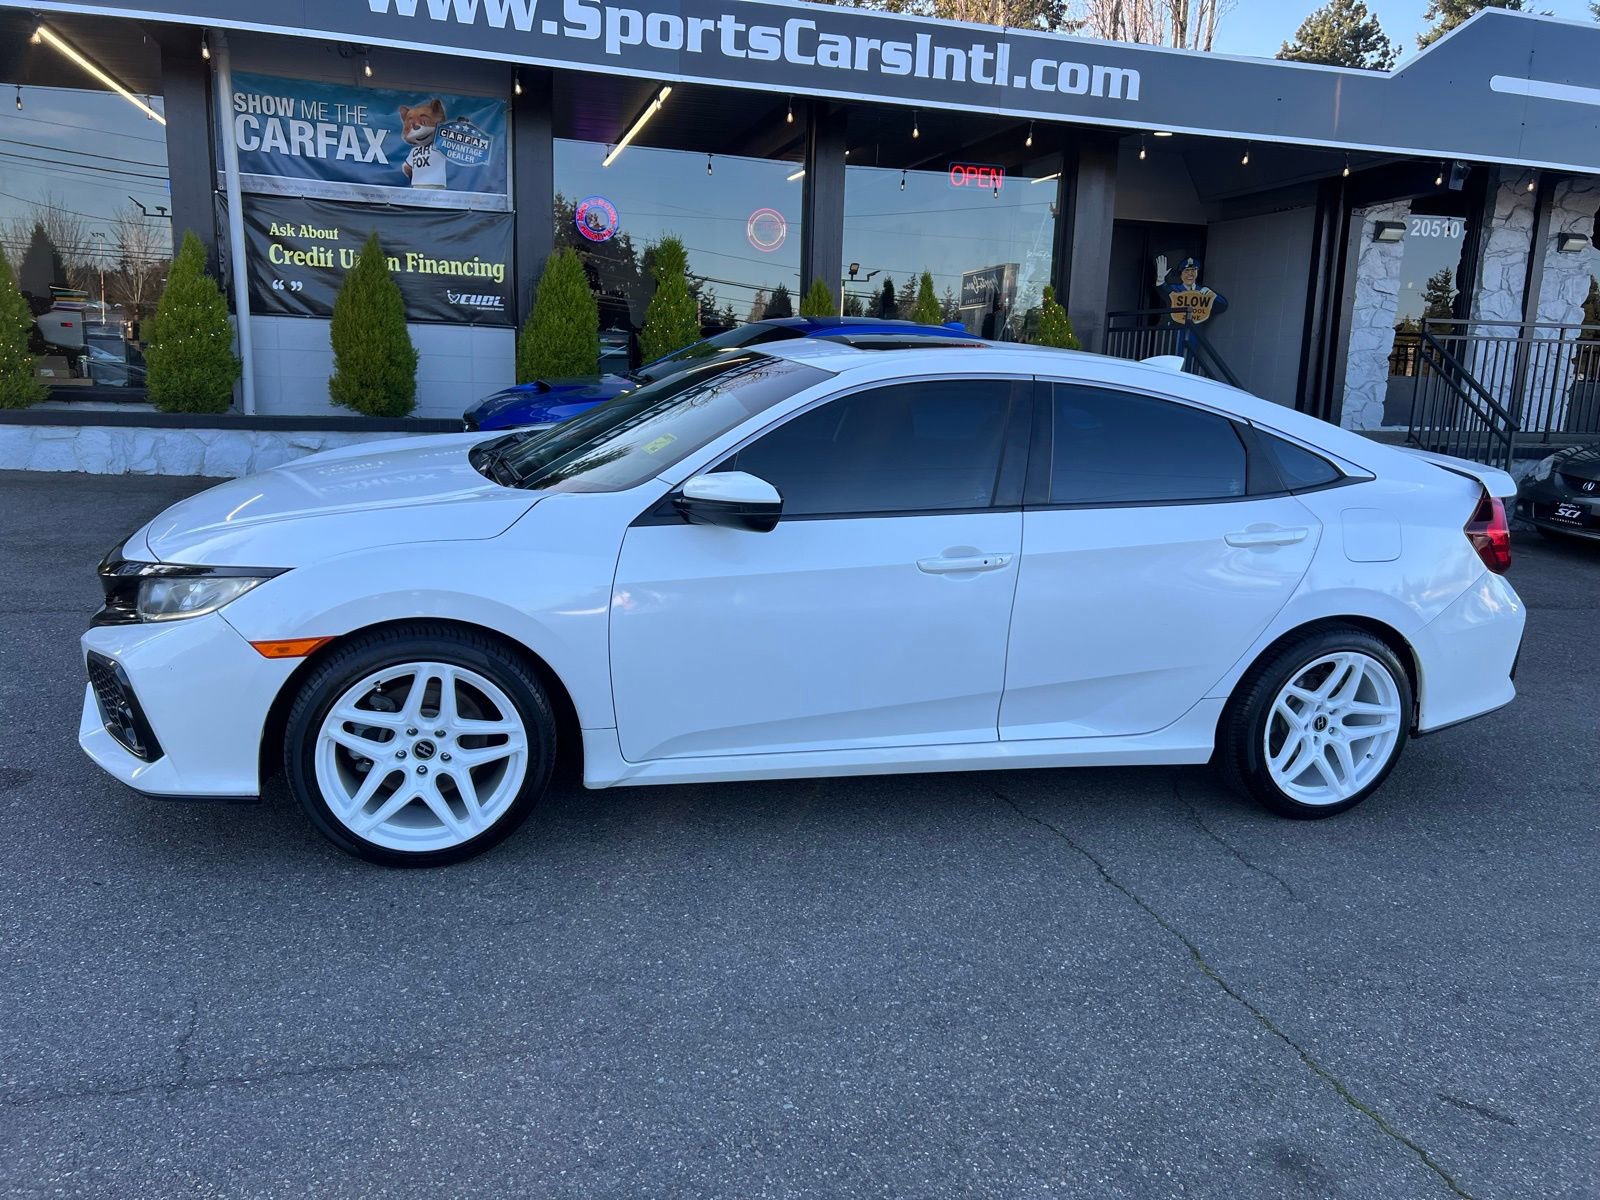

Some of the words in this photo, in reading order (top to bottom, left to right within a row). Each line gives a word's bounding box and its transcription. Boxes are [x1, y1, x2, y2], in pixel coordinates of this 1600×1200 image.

[233, 92, 294, 117] SHOW
[300, 99, 329, 121] ME
[333, 103, 368, 126] THE
[234, 114, 389, 165] CARFAX
[440, 128, 489, 149] CARFAX
[441, 140, 484, 158] ADVANTAGE
[412, 156, 431, 169] FOX
[447, 150, 475, 163] DEALER
[950, 165, 1003, 189] OPEN
[269, 222, 296, 237] Ask
[299, 224, 339, 240] About
[1410, 218, 1461, 239] 20510
[268, 243, 334, 268] Credit
[406, 252, 505, 283] Financing
[1176, 296, 1211, 308] SLOW
